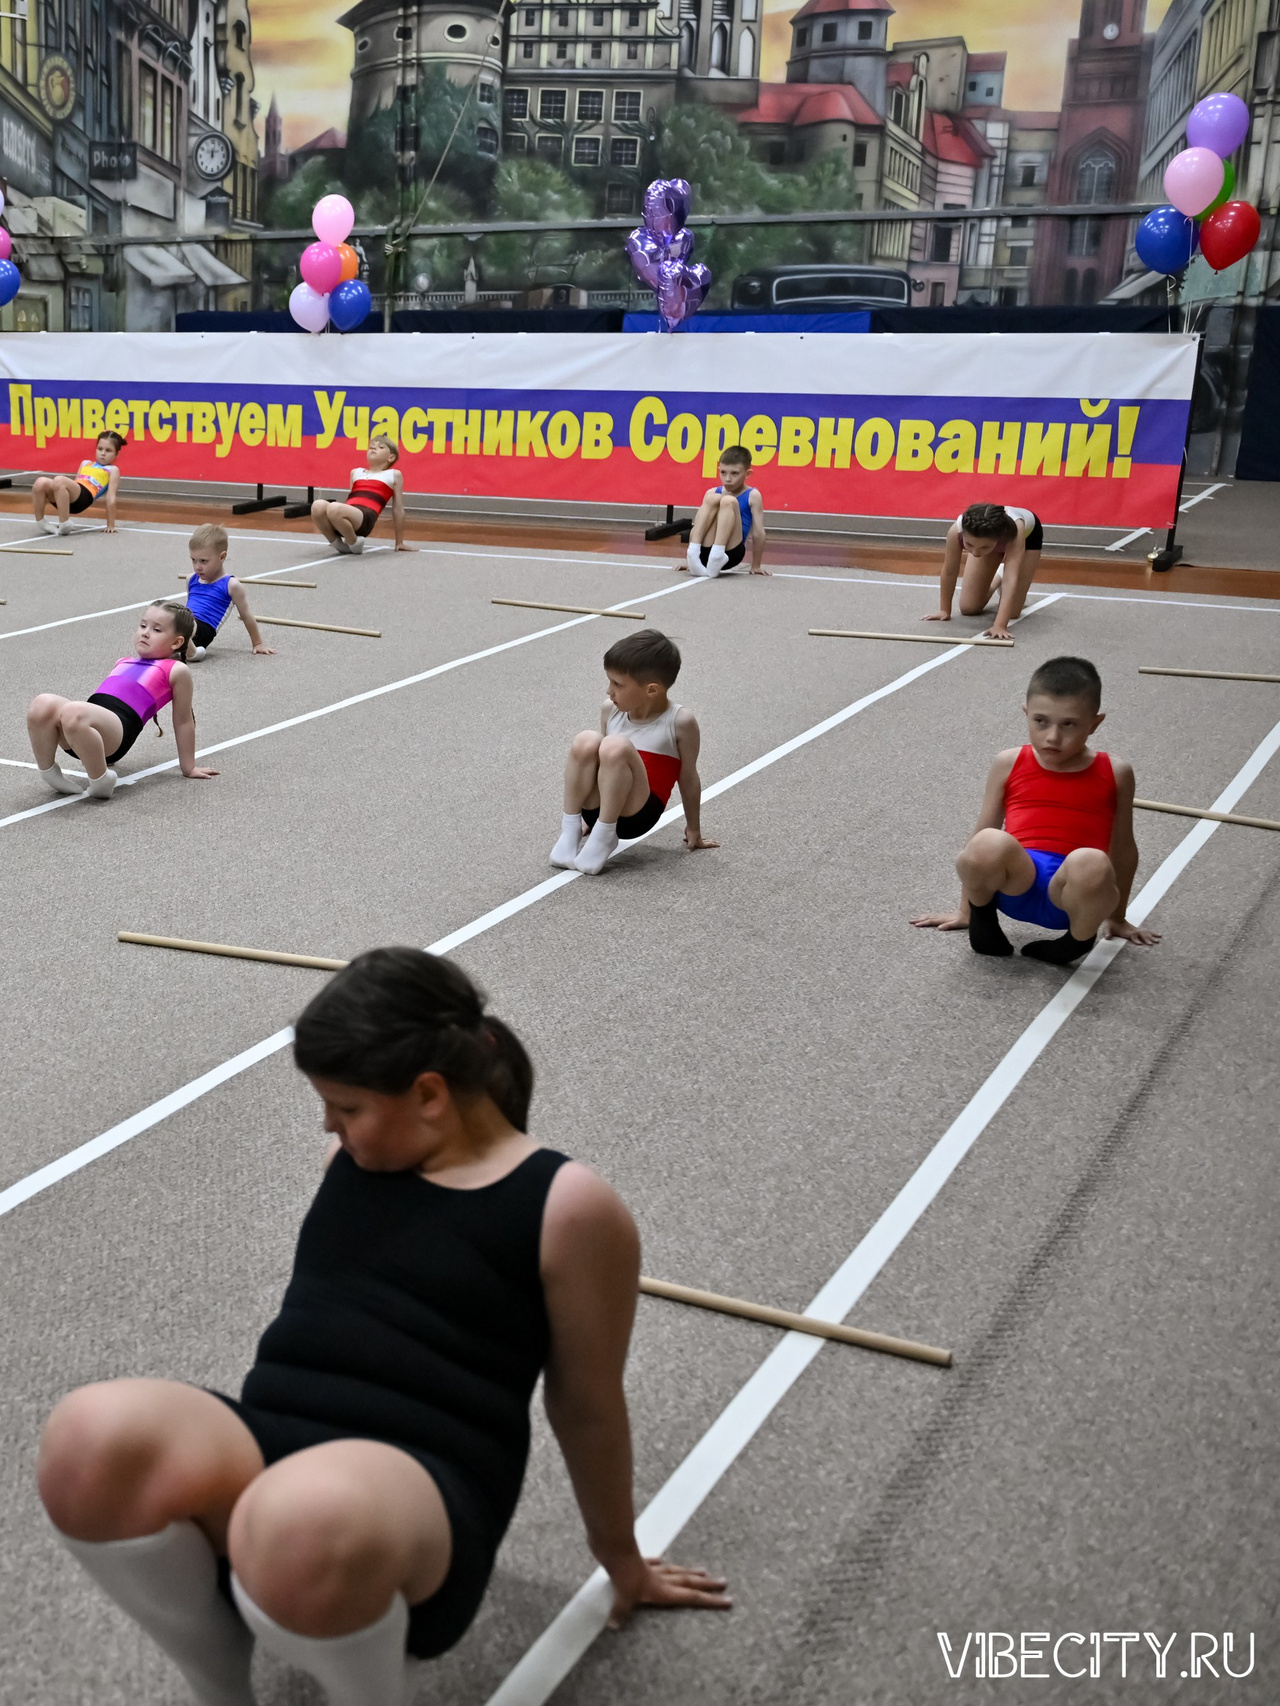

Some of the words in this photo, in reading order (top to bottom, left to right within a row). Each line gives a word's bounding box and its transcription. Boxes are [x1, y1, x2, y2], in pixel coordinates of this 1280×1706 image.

[8, 383, 303, 459] Приветствуем
[314, 390, 614, 460] Участников
[629, 395, 1141, 479] Соревнований!
